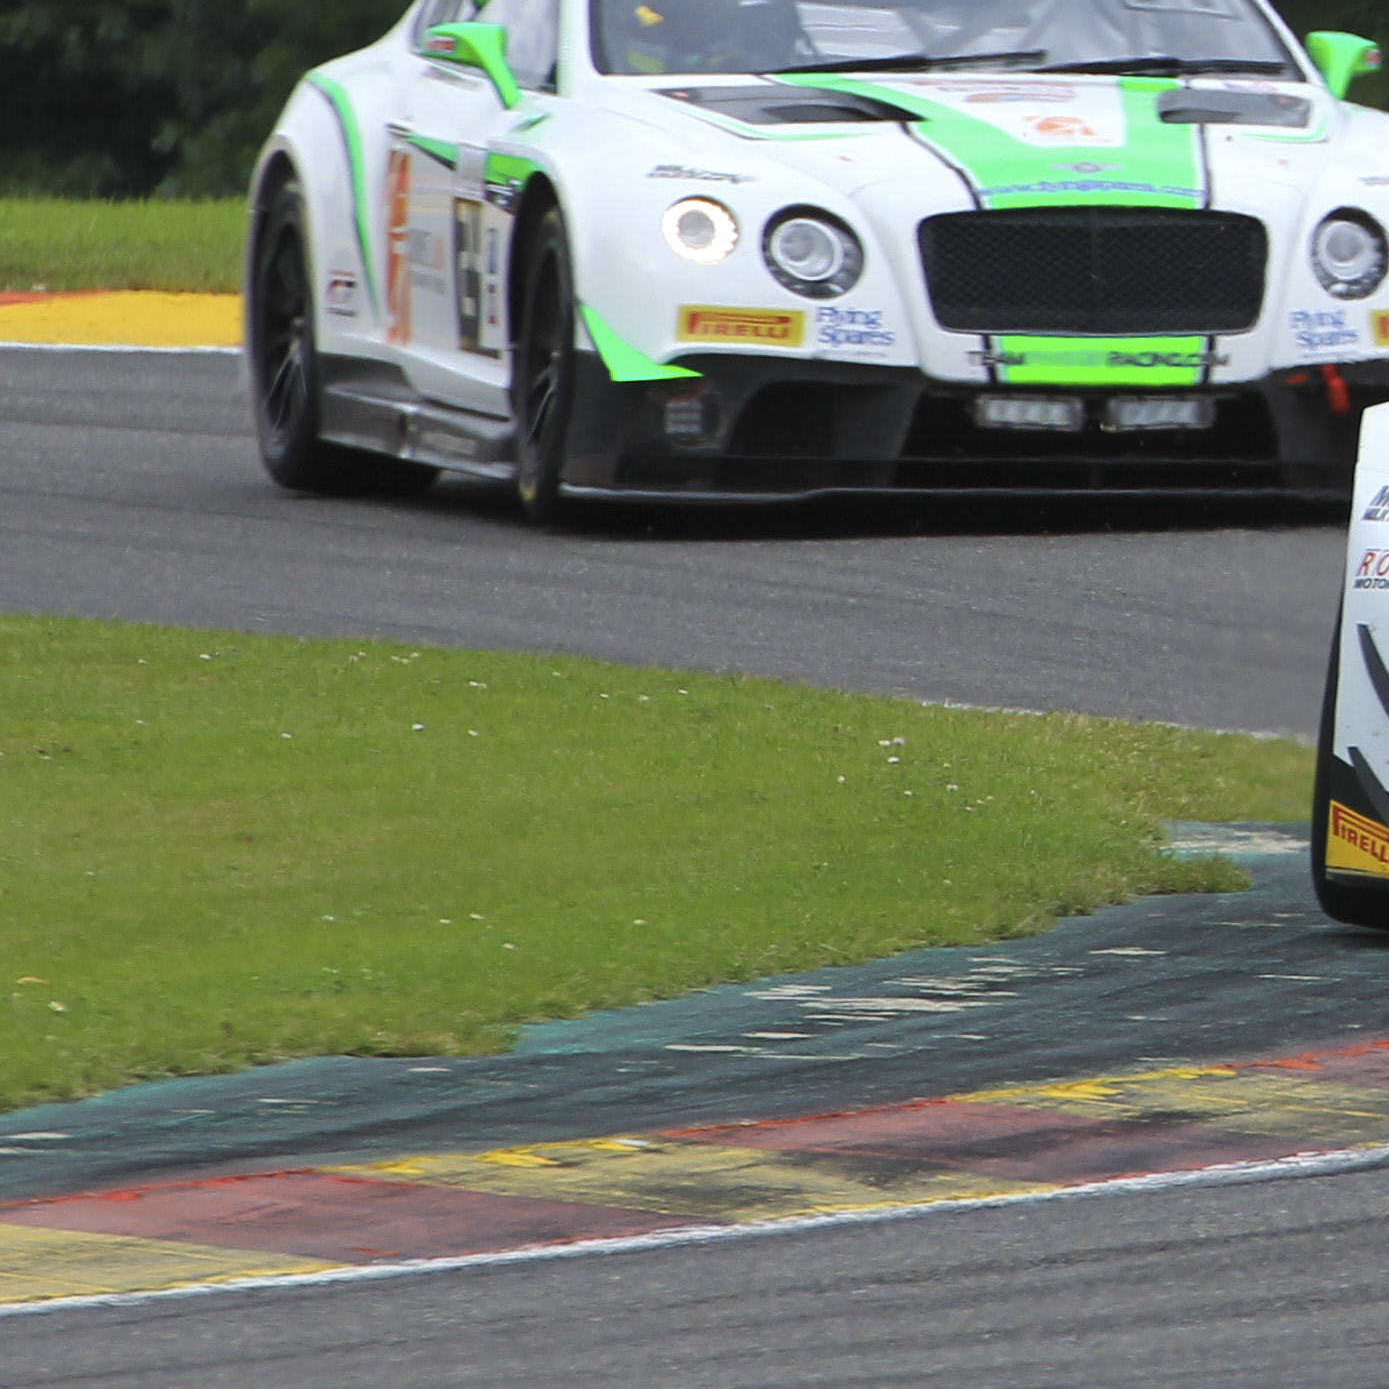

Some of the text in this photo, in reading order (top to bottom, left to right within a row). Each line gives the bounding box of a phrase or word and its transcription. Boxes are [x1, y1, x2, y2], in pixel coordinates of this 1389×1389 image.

[686, 310, 792, 339] PIRELLI
[816, 306, 882, 329] Flying
[817, 326, 895, 347] Spares
